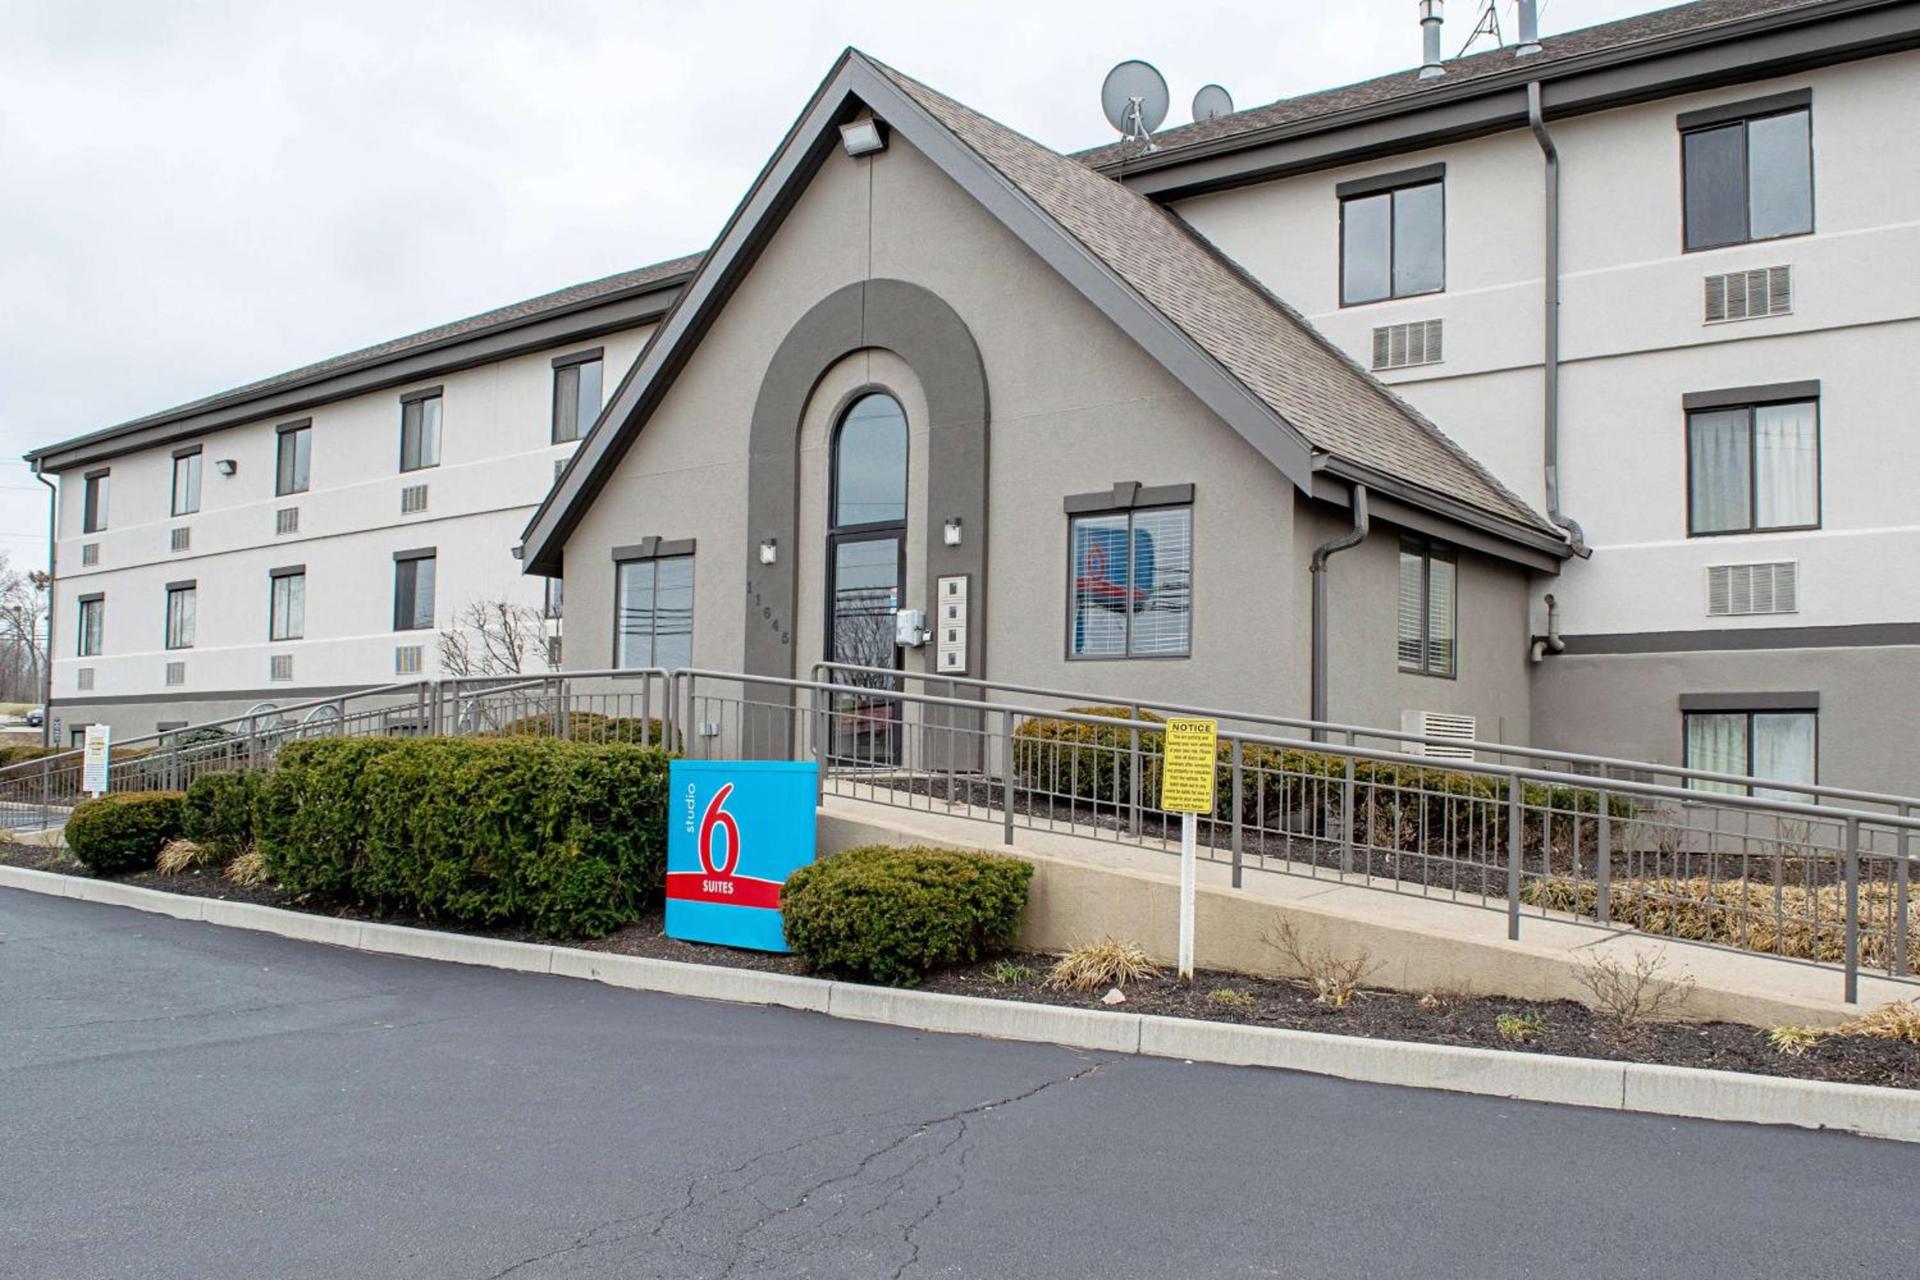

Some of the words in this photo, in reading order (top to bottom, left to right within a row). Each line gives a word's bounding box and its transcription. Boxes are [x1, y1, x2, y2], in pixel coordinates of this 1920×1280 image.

[747, 581, 789, 644] 11645
[1172, 723, 1211, 732] NOTICE
[685, 783, 696, 833] studio
[698, 782, 740, 876] 6
[703, 880, 733, 894] SUITES
